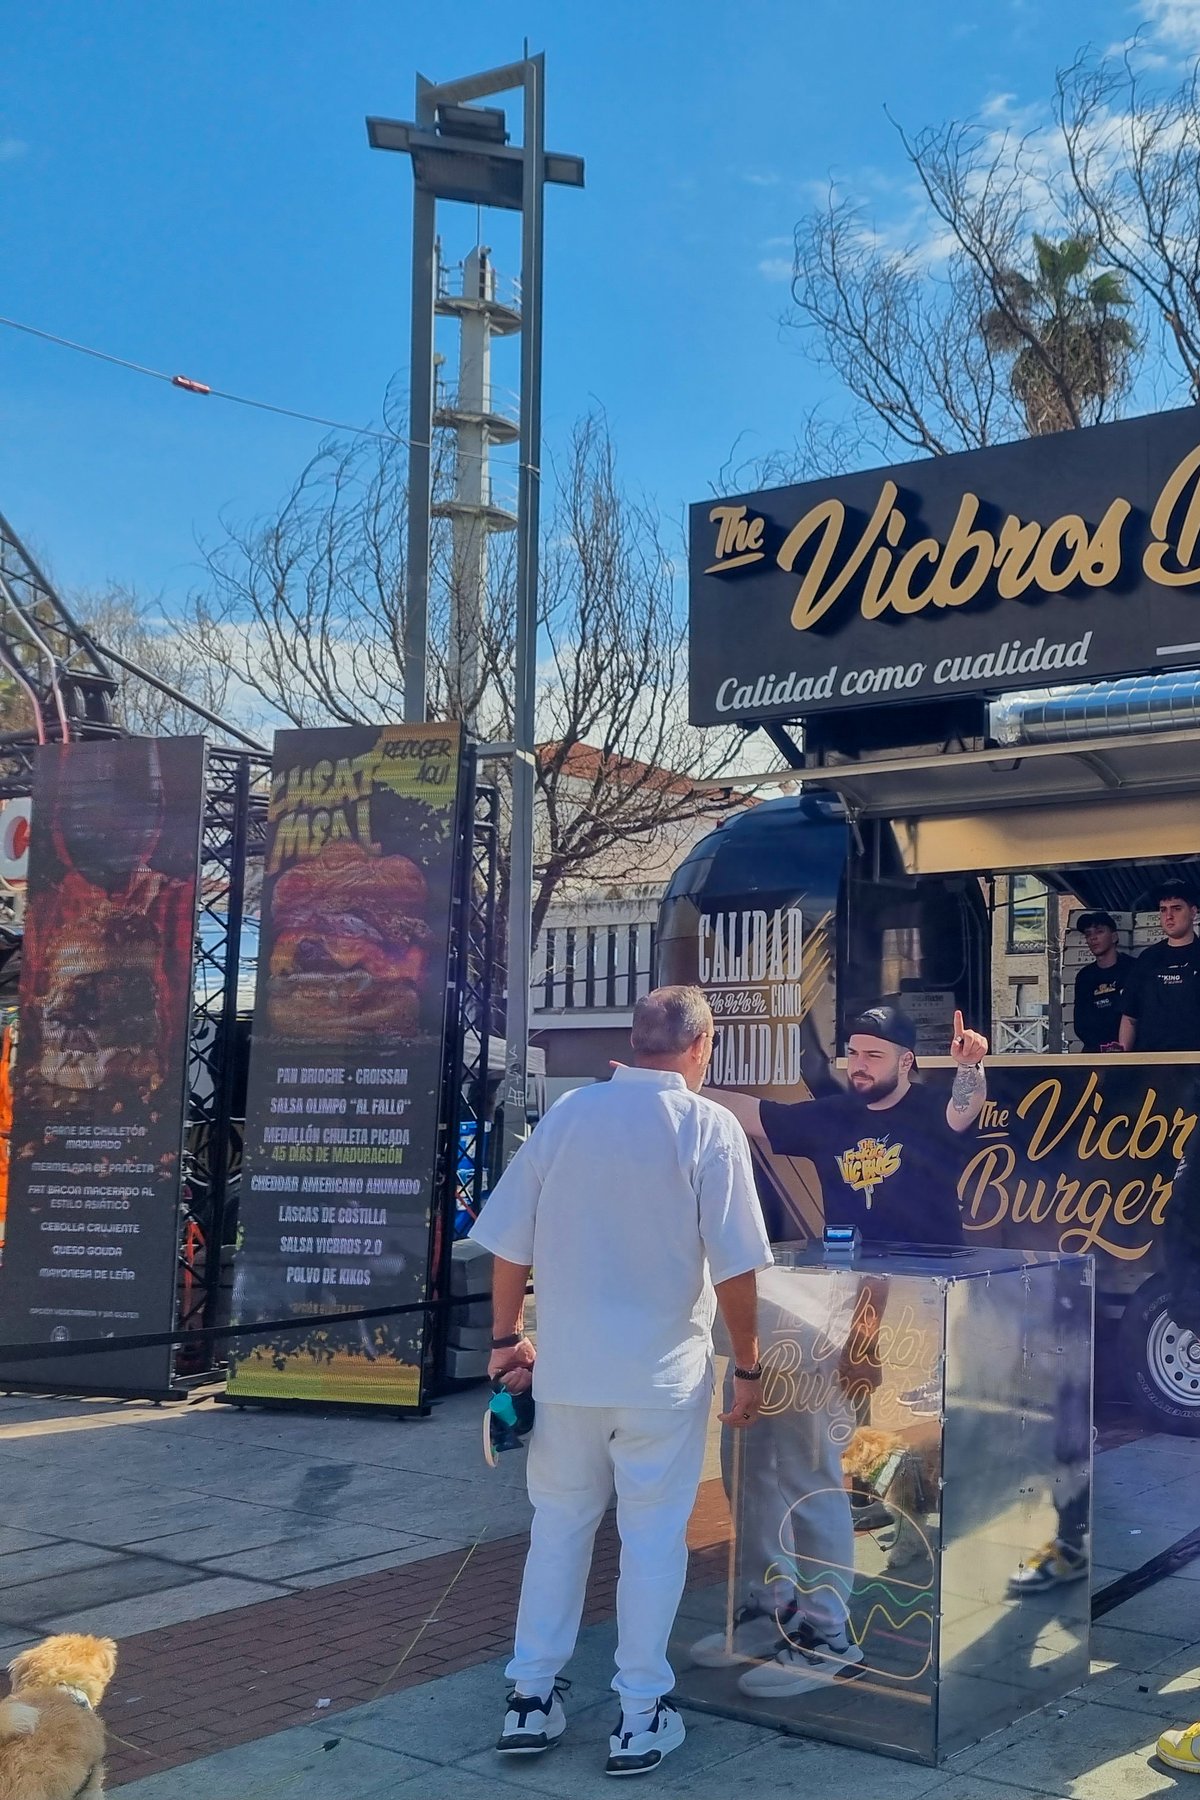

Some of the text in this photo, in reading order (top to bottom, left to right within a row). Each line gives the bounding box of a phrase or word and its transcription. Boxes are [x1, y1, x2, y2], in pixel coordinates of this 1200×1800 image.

[709, 505, 764, 559] The
[777, 480, 1132, 630] Vicbros
[715, 631, 1093, 712] Calidad como cualidad
[383, 738, 452, 760] RECOGER
[698, 907, 803, 984] CALIDAD
[771, 983, 801, 1017] COMO
[704, 1023, 801, 1086] UALIDAD
[277, 1068, 298, 1084] PAN
[301, 1068, 345, 1085] BRIOCHE
[355, 1069, 408, 1085] CROISSAN
[270, 1098, 303, 1114] SALSA
[306, 1098, 346, 1114] OLIMPO
[978, 1071, 1198, 1161] The Vicbr
[79, 1126, 92, 1136] DE
[264, 1124, 410, 1145] MEDALLÓN CHULETA PICADA
[272, 1144, 403, 1164] 45 DÍAS DE MADURACIÓN
[861, 1139, 876, 1150] THE
[48, 1185, 82, 1195] BACON
[83, 1186, 139, 1196] MACERADO
[141, 1187, 155, 1196] AL
[251, 1175, 421, 1195] CHEDDAR AMERICANO AHUMADO
[51, 1199, 82, 1209] ESTILO
[958, 1144, 1174, 1260] Burger
[279, 1205, 387, 1224] LASCAS DE COSTILLA
[40, 1221, 140, 1234] CEBOLLA CRUJIENTE
[52, 1245, 123, 1257] QUESO GOUDA
[280, 1236, 382, 1255] SALSA VICBROS 2.0
[94, 1269, 108, 1279] DE
[287, 1266, 371, 1285] POLVO DE KIKOS
